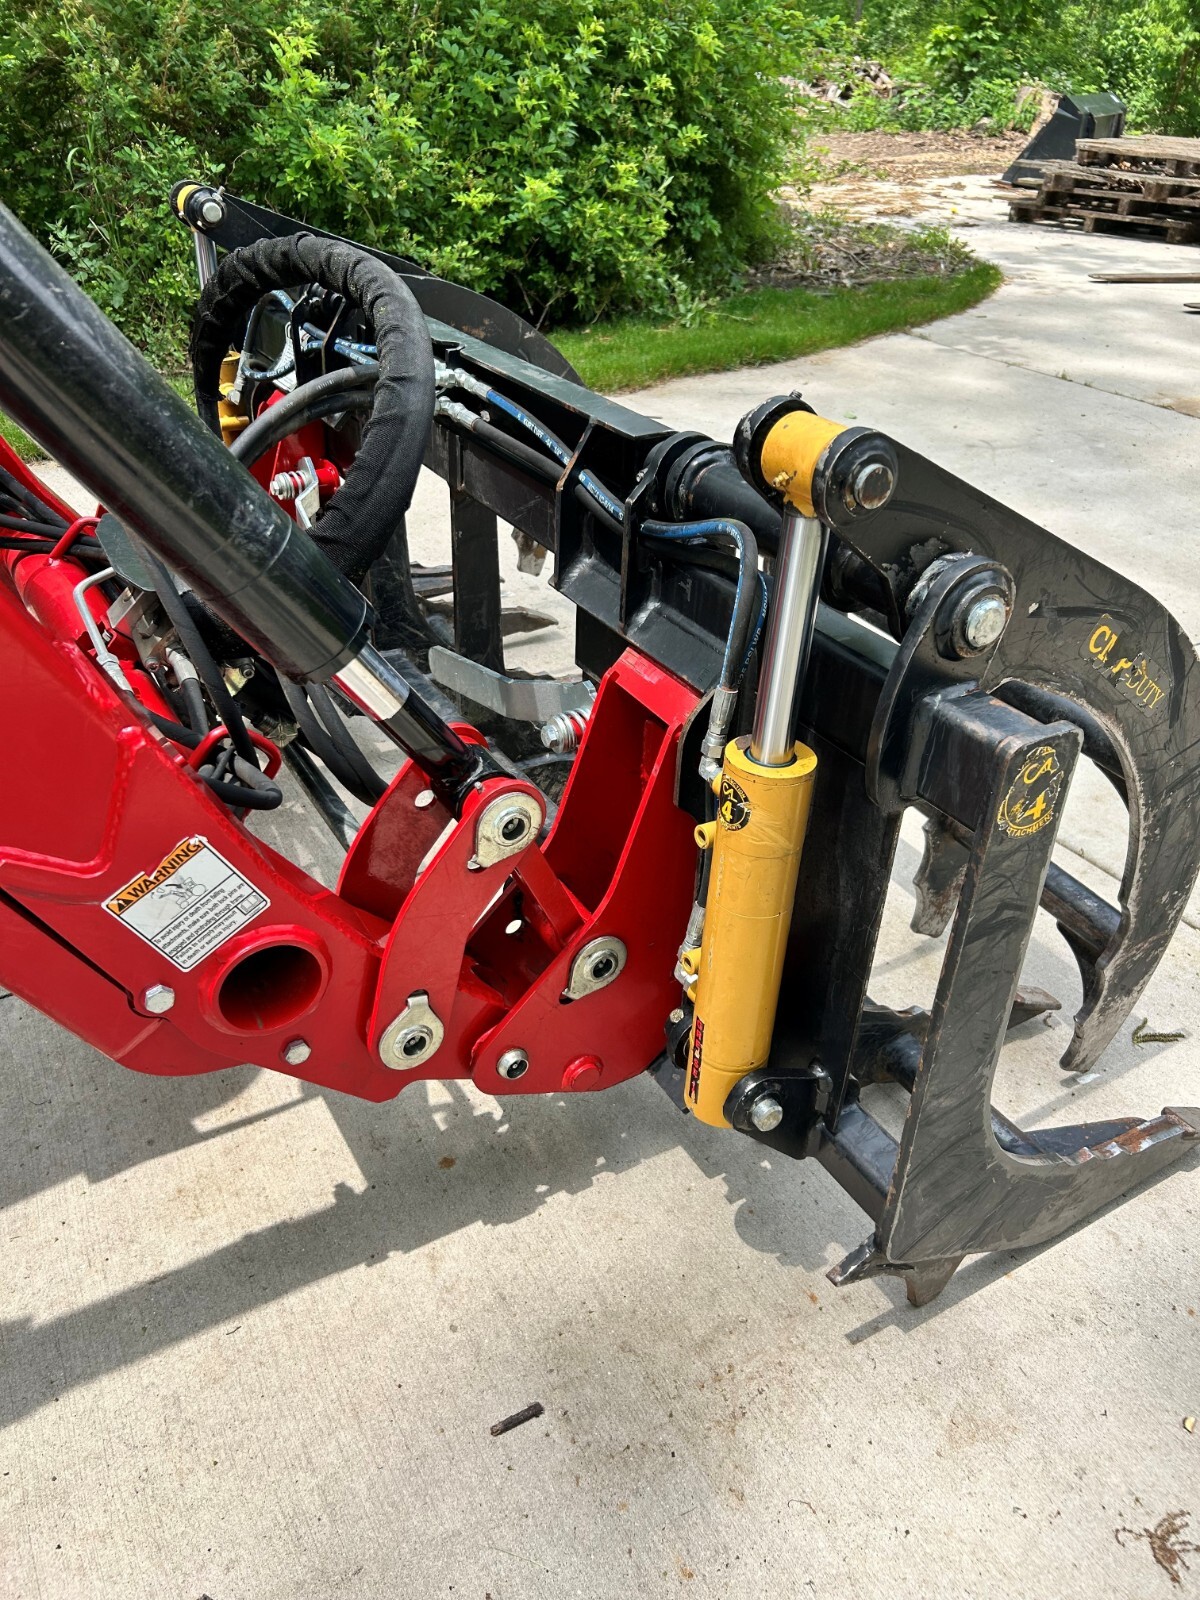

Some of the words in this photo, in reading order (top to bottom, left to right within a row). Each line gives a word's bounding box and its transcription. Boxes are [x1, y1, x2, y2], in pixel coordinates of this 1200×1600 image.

[127, 842, 201, 899] WARNING
[161, 929, 172, 940] avoid
[172, 921, 185, 932] injury
[189, 906, 201, 917] death
[200, 898, 211, 907] from
[210, 888, 225, 900] falling
[169, 940, 187, 955] engaged
[186, 933, 195, 941] and
[194, 916, 217, 935] protruding
[215, 903, 232, 918] through
[188, 918, 200, 929] make
[200, 910, 210, 920] sure
[209, 903, 220, 913] both
[218, 896, 228, 904] lock
[228, 888, 238, 898] pins
[176, 947, 193, 960] Failure
[198, 929, 215, 943] comply
[213, 921, 225, 930] may
[223, 910, 237, 922] result
[187, 949, 200, 961] death
[205, 931, 224, 946] serious
[222, 920, 237, 932] injury.
[692, 1019, 704, 1079] GRESE
